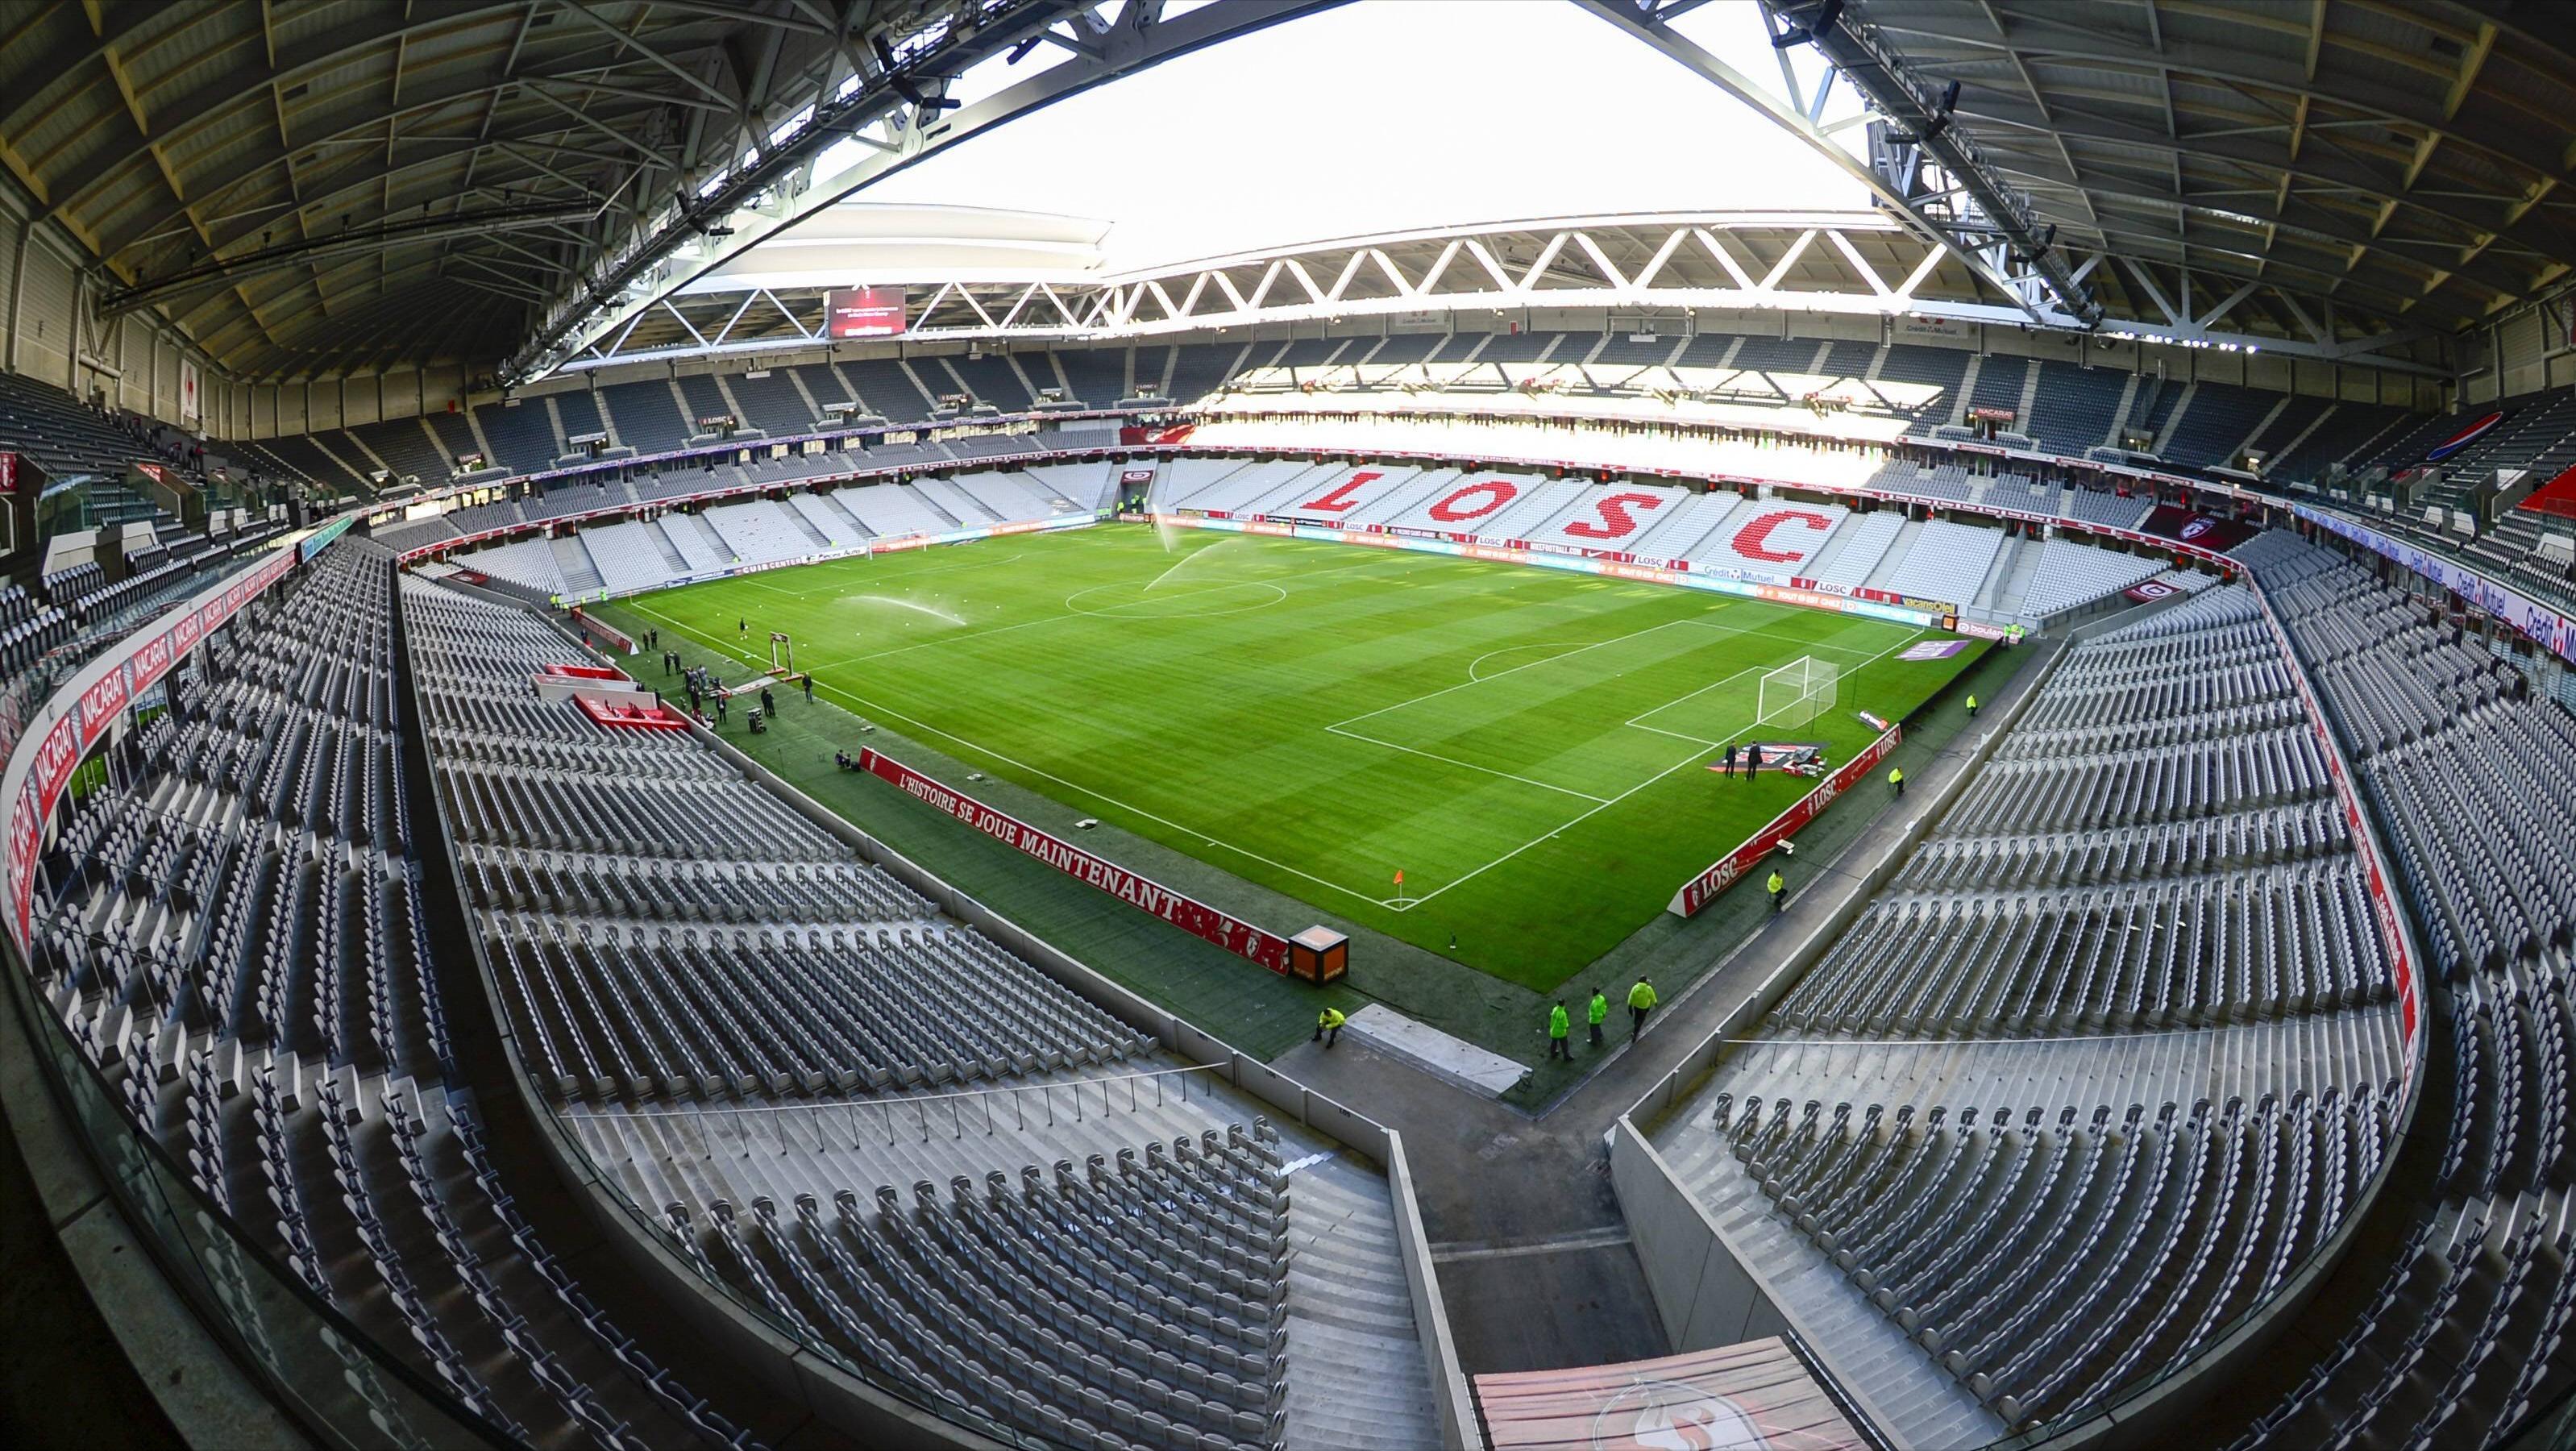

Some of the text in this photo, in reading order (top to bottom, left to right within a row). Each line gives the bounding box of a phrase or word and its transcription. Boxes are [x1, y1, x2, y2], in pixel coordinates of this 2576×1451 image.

[708, 416, 726, 424] LOSC
[1978, 408, 2013, 418] NACARAT
[1299, 472, 1831, 563] LOSC
[1346, 523, 1364, 531] LOSC
[1480, 538, 1501, 546] LOSC
[743, 558, 803, 574] CUIR CENTER
[1638, 556, 1662, 565] LOSC
[1705, 565, 1774, 583] Crédit Mutuel
[2411, 551, 2443, 583] Crédit Mutuel
[1778, 592, 1840, 607] TOUT EST CHEZ
[1819, 584, 1847, 593] LOSC
[2458, 572, 2505, 617] Crédit Mutuel
[174, 614, 198, 648] NACARAT
[2526, 606, 2553, 649] Crédit
[135, 637, 167, 681] NACARAT
[82, 669, 123, 728] NACARAT
[36, 717, 73, 796] NACARAT
[1880, 730, 1897, 756] LOSC
[1814, 779, 1837, 811] LOSC
[900, 773, 1182, 921] L'HISTOIRE SE JOUE MAINTENANT
[1702, 856, 1738, 900] LOSC
